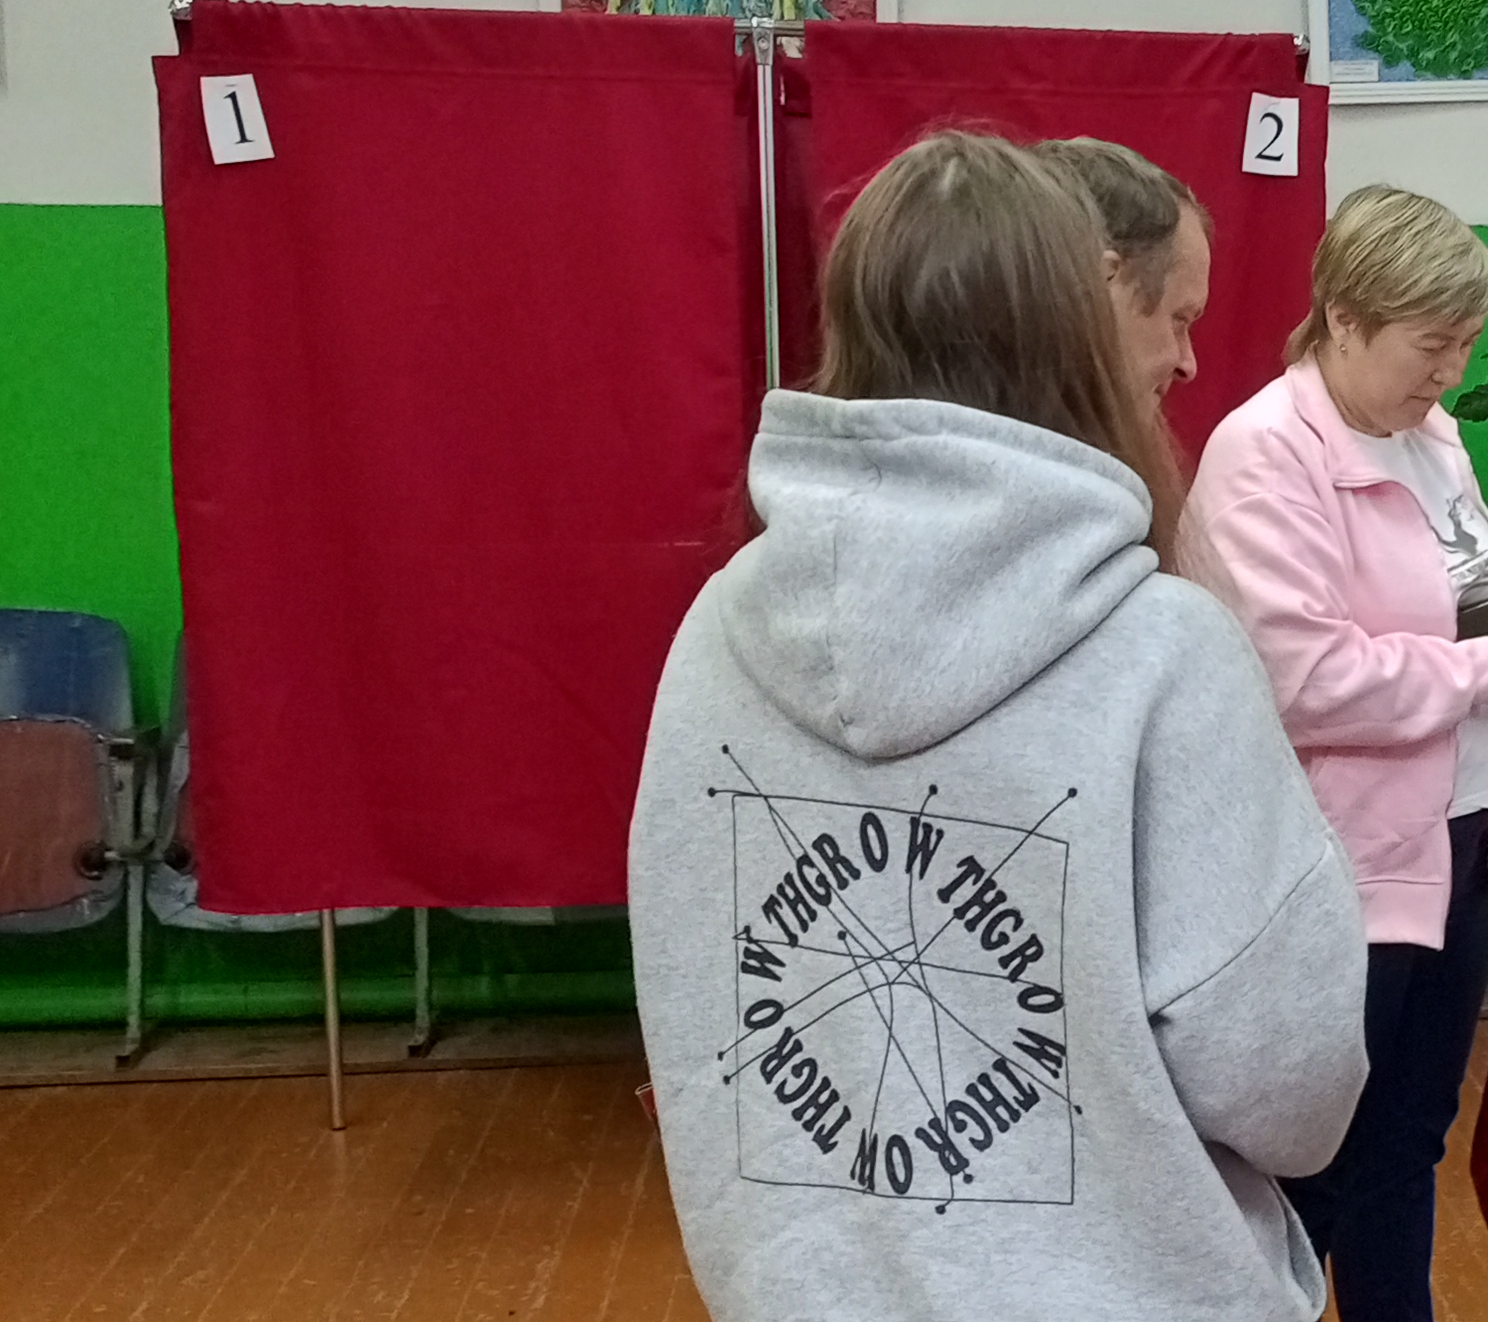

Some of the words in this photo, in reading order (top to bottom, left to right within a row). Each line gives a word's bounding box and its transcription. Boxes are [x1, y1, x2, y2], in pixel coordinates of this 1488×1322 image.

[223, 90, 255, 144] 1
[1254, 112, 1284, 162] 2
[761, 811, 944, 948] THGROW
[937, 855, 1067, 1079] THGROW
[850, 1058, 1041, 1196] THGROW
